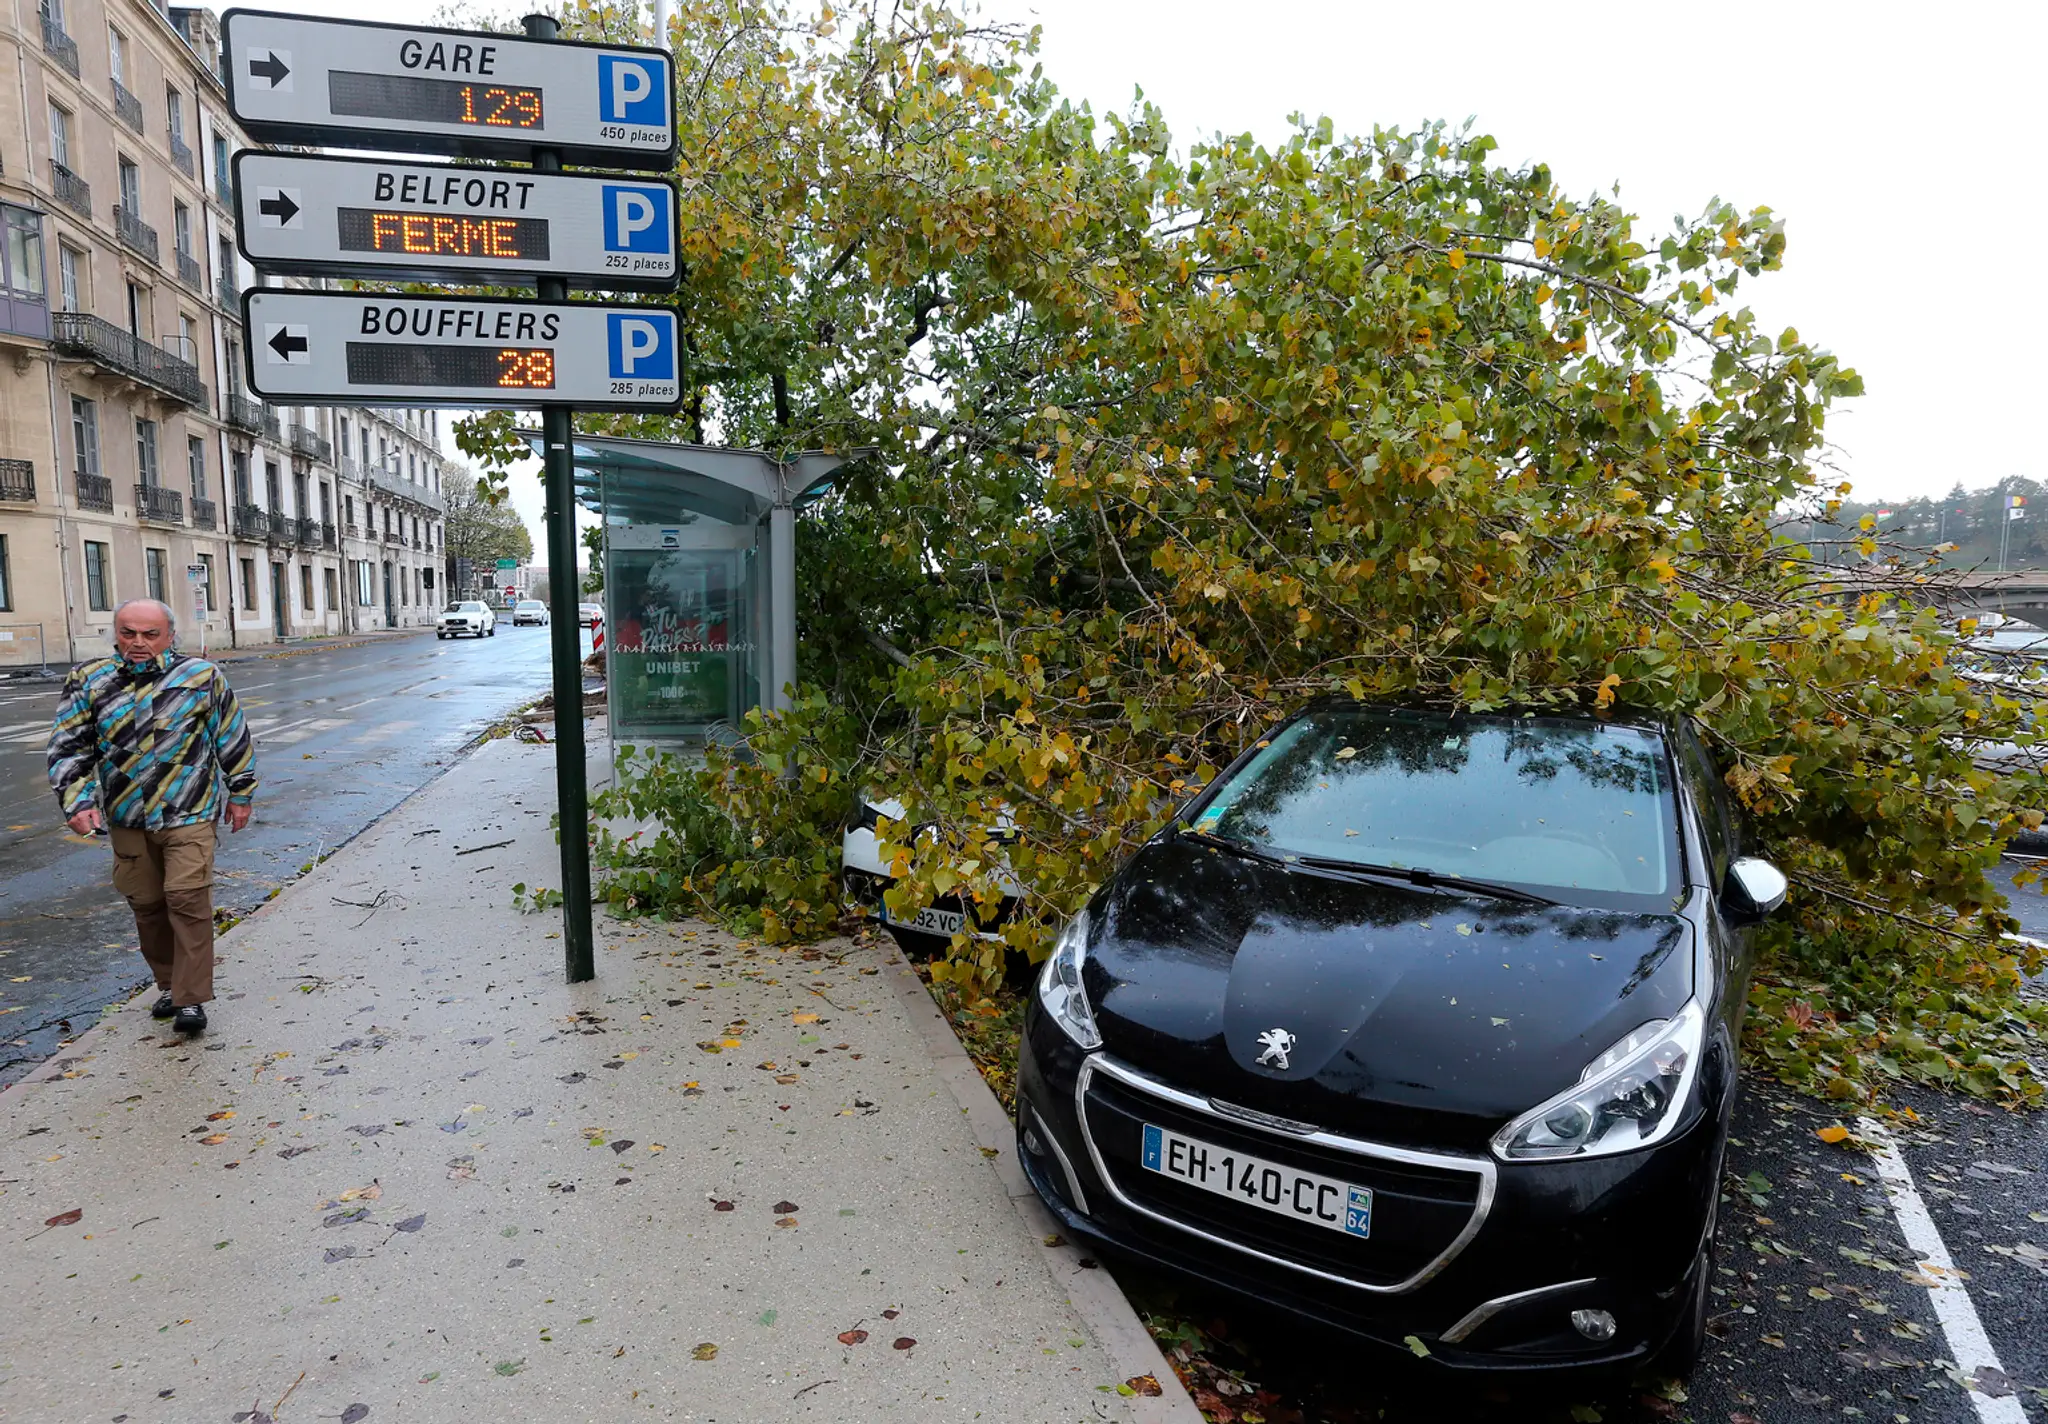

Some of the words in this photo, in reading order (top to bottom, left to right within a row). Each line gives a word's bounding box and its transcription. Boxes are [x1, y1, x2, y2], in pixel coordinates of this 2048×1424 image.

[400, 40, 497, 75] GARE
[460, 86, 541, 126] 129
[612, 61, 651, 118] P
[600, 127, 625, 139] 450
[630, 130, 667, 143] places
[375, 173, 535, 210] BELFORT
[373, 214, 519, 256] FERME
[616, 191, 655, 247] P
[606, 256, 629, 269] 252
[634, 257, 670, 271] places
[361, 306, 560, 340] BOUFFLERS
[621, 318, 659, 374] P
[498, 350, 552, 386] 28
[610, 383, 633, 395] 285
[638, 384, 674, 397] places
[649, 605, 677, 632] TU
[646, 661, 700, 674] UNIBET
[1149, 1152, 1155, 1162] F
[1168, 1138, 1339, 1222] EH-140-CC
[1347, 1210, 1367, 1232] 64
